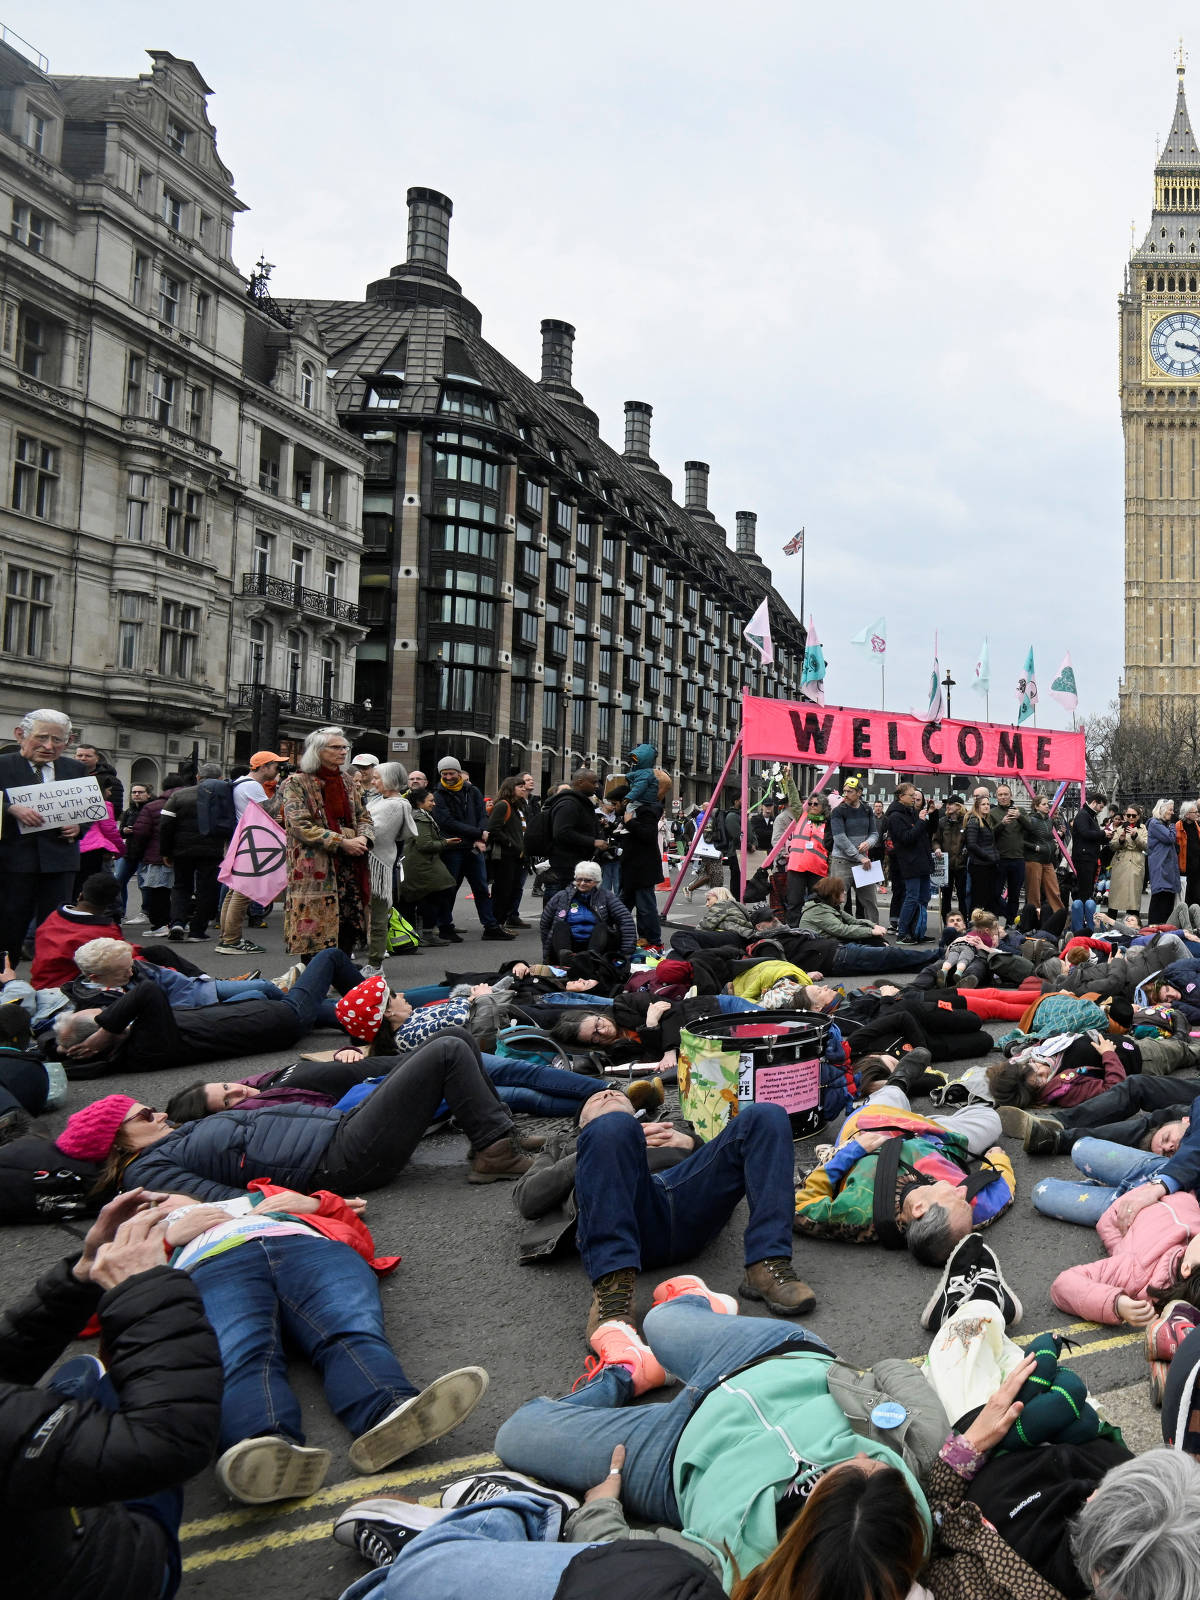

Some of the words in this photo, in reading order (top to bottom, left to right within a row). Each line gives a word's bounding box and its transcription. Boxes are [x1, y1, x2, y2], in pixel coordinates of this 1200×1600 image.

[789, 710, 1052, 772] WELCOME
[12, 792, 32, 803] NOT
[40, 787, 82, 800] ALLOWED
[37, 802, 54, 812] BUT
[58, 798, 83, 808] WITH
[45, 812, 65, 823] THE
[68, 809, 87, 820] WAY
[739, 1086, 750, 1096] FE
